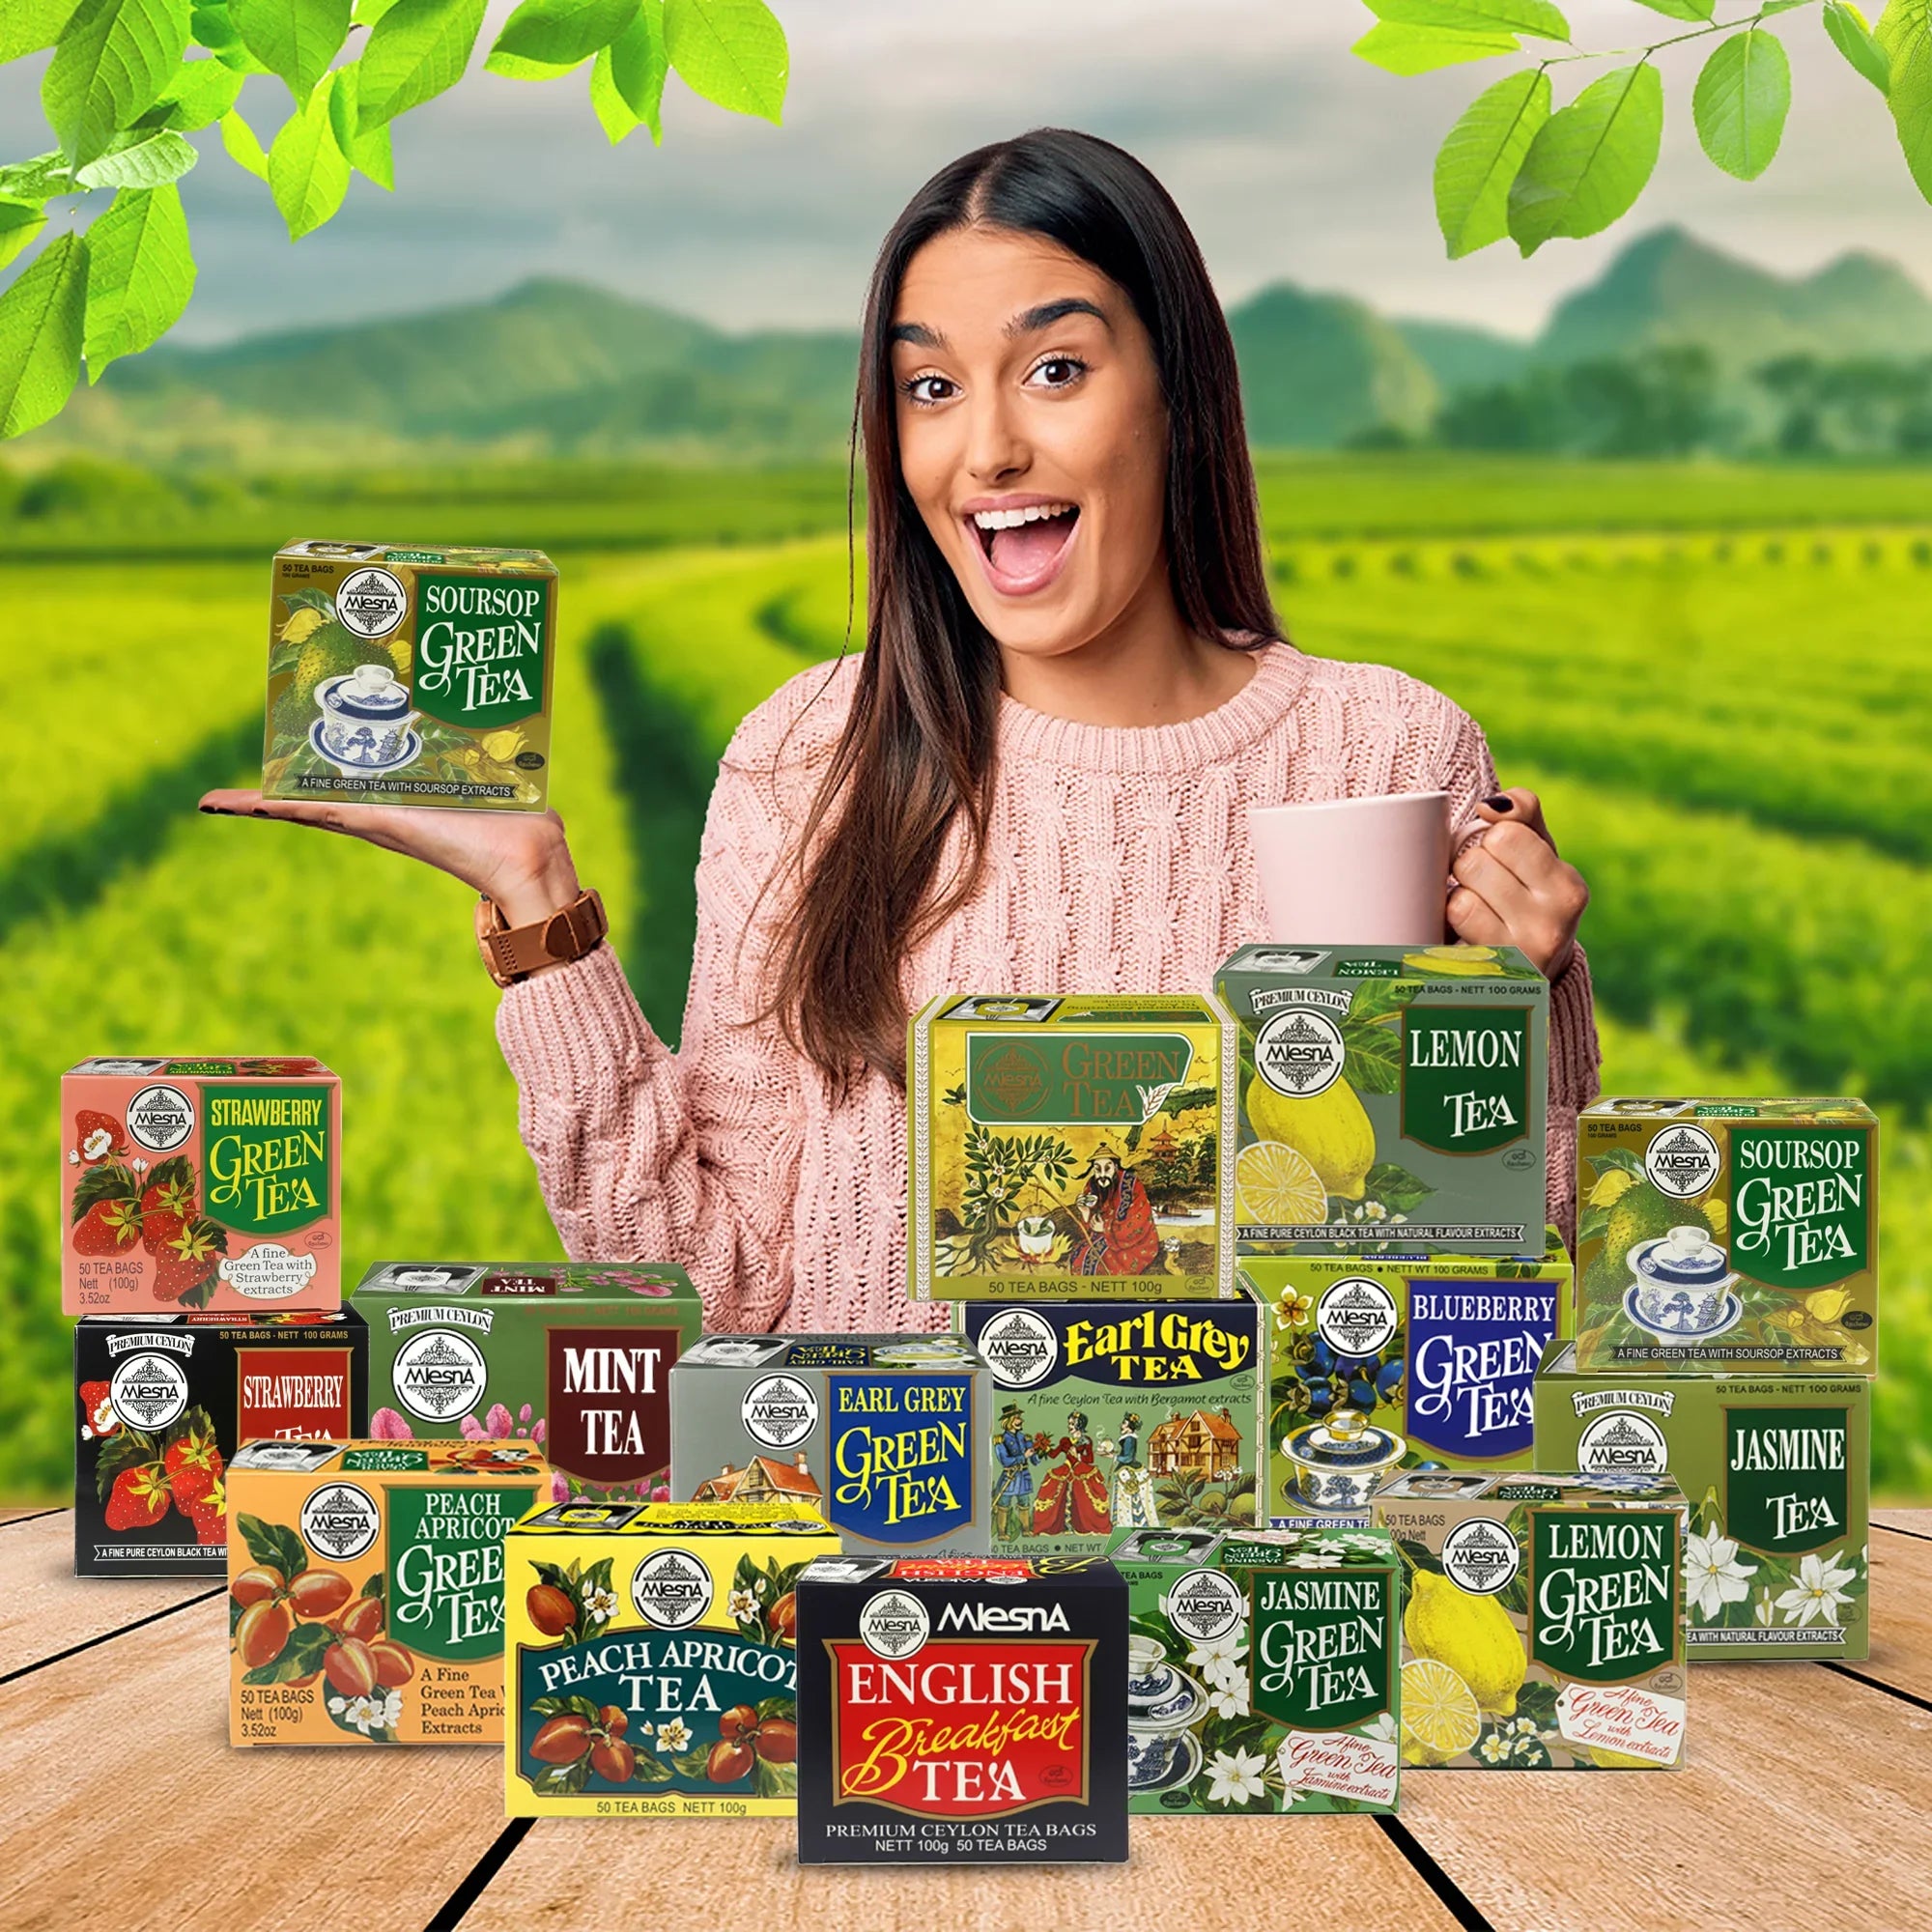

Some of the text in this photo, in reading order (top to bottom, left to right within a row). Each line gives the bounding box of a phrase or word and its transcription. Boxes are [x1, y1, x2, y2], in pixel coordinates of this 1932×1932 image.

[425, 584, 540, 617] SOURSOP
[419, 619, 541, 697] GREEN
[455, 667, 533, 712] TEA
[302, 779, 511, 797] A FINE GREEN TEA WITH SOURSOP EXTRACTS
[1255, 990, 1348, 1009] PREMIUM CEYLON
[1063, 1041, 1180, 1082] GREEN
[1409, 1030, 1522, 1068] LEMON
[211, 1099, 323, 1126] STRAWBERRY
[1064, 1081, 1139, 1118] TEA
[1443, 1091, 1518, 1138] TEA
[210, 1129, 325, 1209] GREEN
[1740, 1139, 1861, 1170] SOURSOP
[244, 1175, 321, 1222] TEA
[1736, 1172, 1863, 1258] GREEN
[1242, 1228, 1517, 1238] A FINE PURE CEYLON BLACK TEA WITH NATURAL FLAVOUR EXTRACTS
[1774, 1220, 1857, 1271] TEA
[79, 1262, 144, 1275] 50 TEA BAGS
[224, 1260, 313, 1271] Green Tea with
[251, 1248, 286, 1259] A fine
[79, 1277, 139, 1292] Nett (100g)
[236, 1272, 302, 1285] Strawberry
[243, 1286, 294, 1294] extracts
[988, 1280, 1162, 1295] 50 TEA BAGS NETT 100g
[79, 1293, 110, 1304] 3.52oz
[1412, 1294, 1555, 1322] BLUEBERRY
[391, 1308, 491, 1329] PREMIUM CEYLON
[110, 1335, 192, 1352] PREMIUM CEYLON
[1064, 1310, 1250, 1370] Earl Grey
[1617, 1349, 1837, 1359] A FINE GREEN TEA WITH SOURSOP EXTRACTS
[563, 1348, 661, 1394] MINT
[1112, 1354, 1203, 1381] TEA
[1414, 1330, 1552, 1422] GREEN
[243, 1376, 344, 1409] STRAWBERRY
[838, 1386, 967, 1413] EARL GREY
[1028, 1394, 1252, 1407] A fine Ceylon Tea with Bergamot extracts
[1576, 1391, 1671, 1412] PREMIUM CEYLON
[581, 1409, 645, 1455] TEA
[835, 1420, 967, 1511] GREEN
[1730, 1429, 1845, 1472] JASMINE
[424, 1492, 501, 1516] PEACH
[875, 1469, 961, 1525] TEA
[413, 1516, 515, 1540] APRICOT
[1766, 1492, 1839, 1541] TEA
[101, 1548, 107, 1557] A
[108, 1548, 125, 1557] FINE
[147, 1548, 175, 1556] CEYLON
[177, 1548, 201, 1556] BLACK
[203, 1548, 217, 1556] TEA
[1548, 1524, 1664, 1560] LEMON
[1260, 1580, 1379, 1611] JASMINE
[1539, 1563, 1670, 1652] GREEN
[1578, 1614, 1664, 1667] TEA
[538, 1640, 796, 1691] PEACH APRICOT
[1260, 1615, 1384, 1698] GREEN
[420, 1668, 469, 1682] A Fine
[847, 1662, 1073, 1706] ENGLISH
[1297, 1662, 1378, 1712] TEA
[241, 1690, 314, 1703] 50 TEA BAGS
[421, 1686, 497, 1700] Green Tea
[618, 1674, 722, 1712] TEA
[241, 1707, 303, 1723] Nett (100g)
[421, 1703, 465, 1717] Peach
[1569, 1688, 1680, 1736] Green Tea
[241, 1724, 276, 1737] 3.52oz
[421, 1721, 482, 1735] Extracts
[1573, 1719, 1673, 1758] Lemon extracts
[1607, 1725, 1633, 1736] with
[841, 1707, 1080, 1797] Breakfast
[1288, 1737, 1396, 1778] Green Tea
[912, 1759, 1027, 1802] TEA
[1289, 1768, 1391, 1800] Jasmine extracts
[1327, 1772, 1350, 1781] with
[597, 1802, 747, 1816] 50 TEA BAGS NETT 100g
[826, 1824, 1097, 1836] PREMIUM CEYLON TEA BAGS
[875, 1839, 1047, 1854] NETT 100g 50 TEA BAGS
